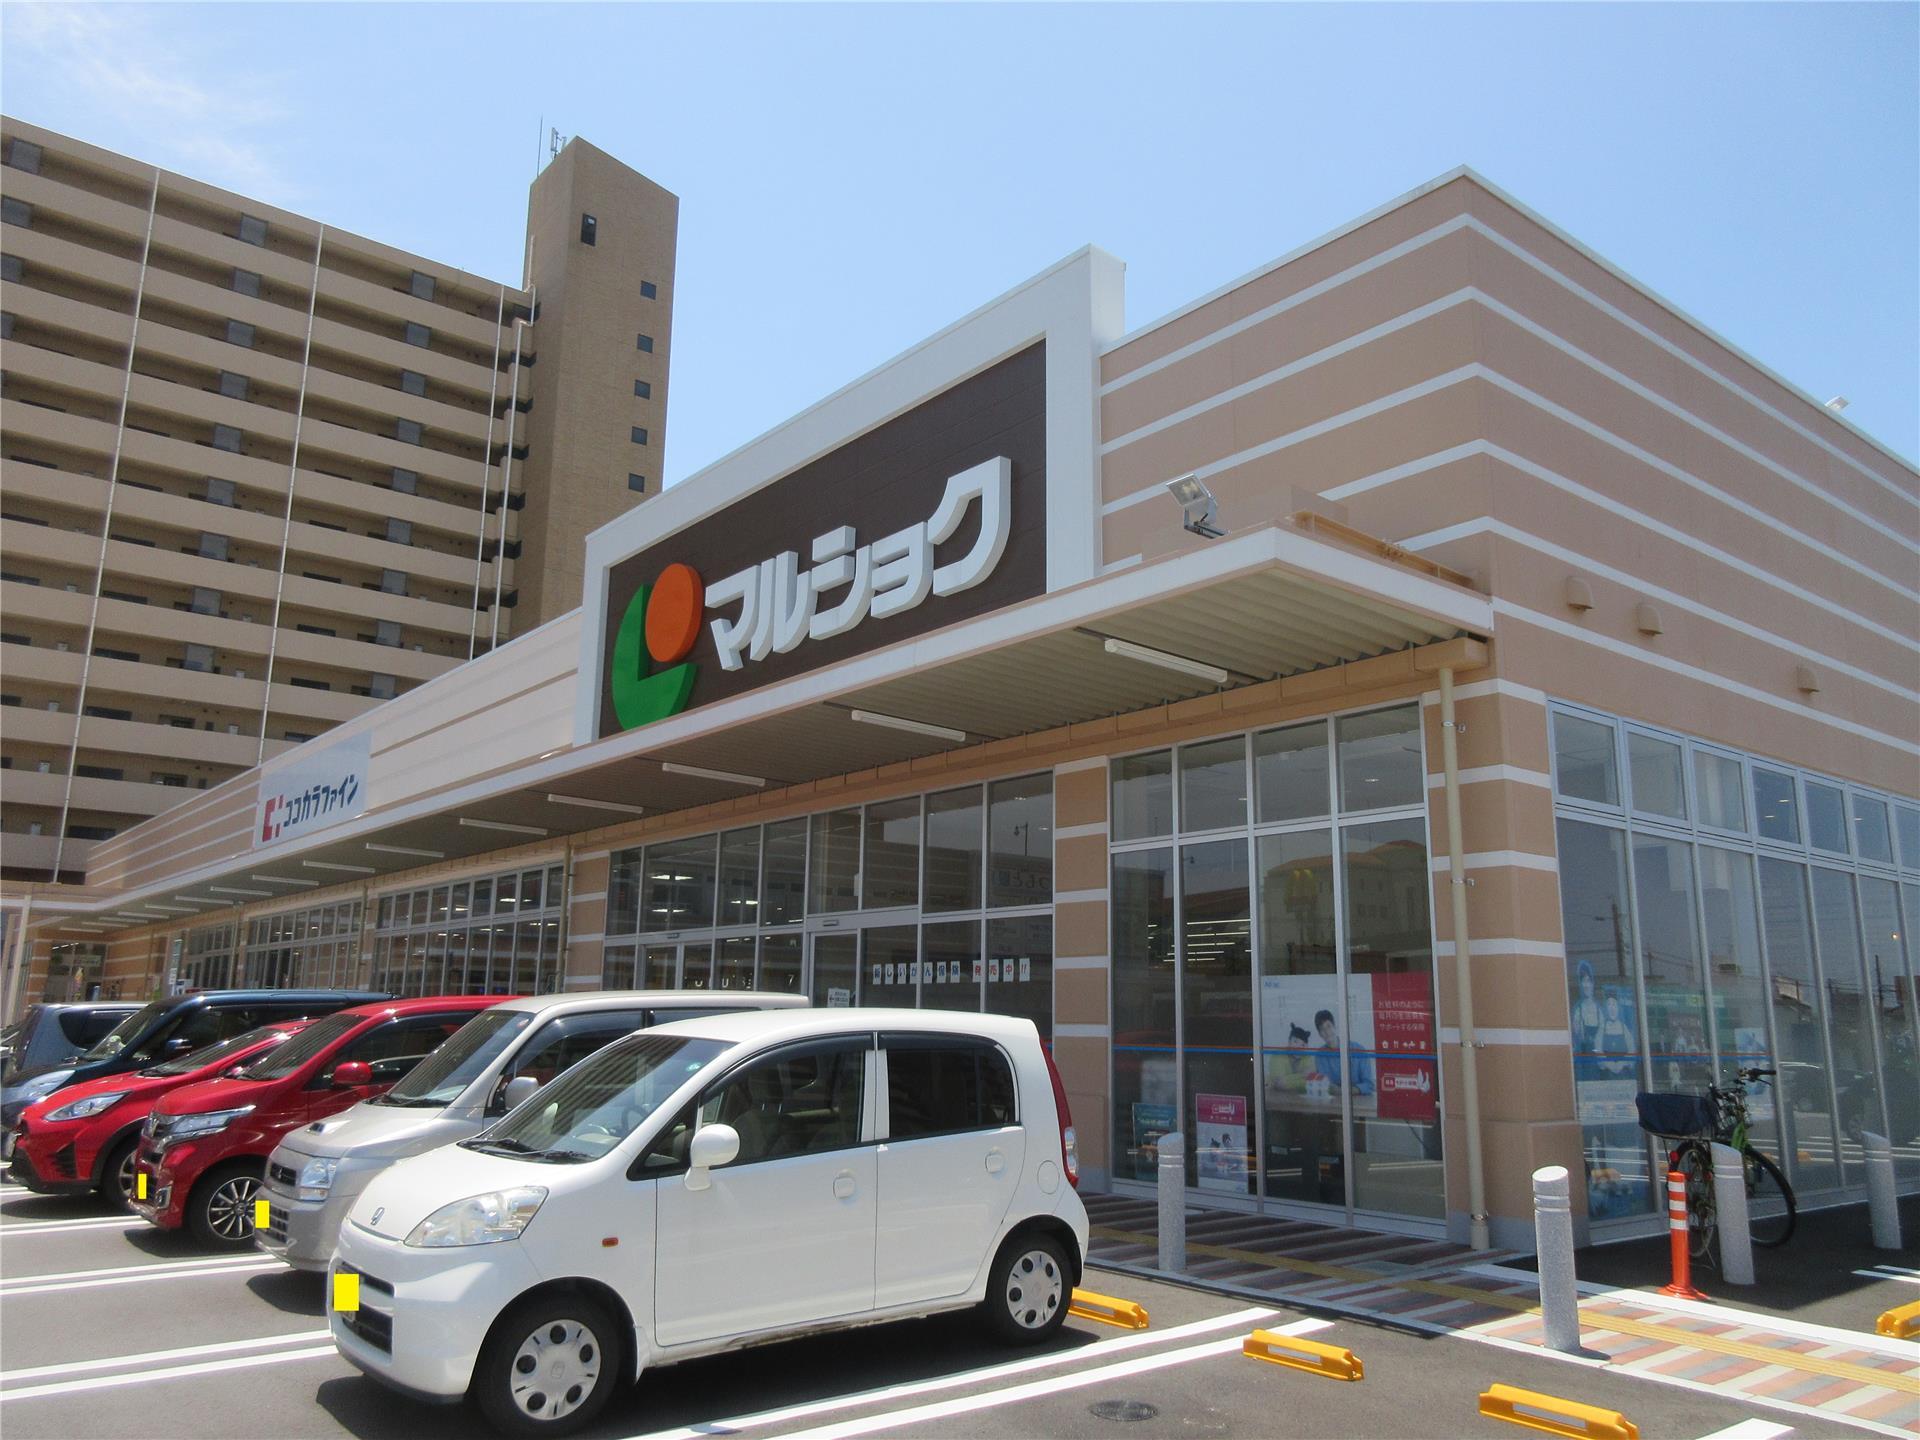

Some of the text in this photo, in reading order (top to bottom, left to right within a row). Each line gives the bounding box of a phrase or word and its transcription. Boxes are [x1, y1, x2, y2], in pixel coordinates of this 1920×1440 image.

[705, 455, 1011, 671] マルショク
[284, 774, 359, 828] ココカラファイン
